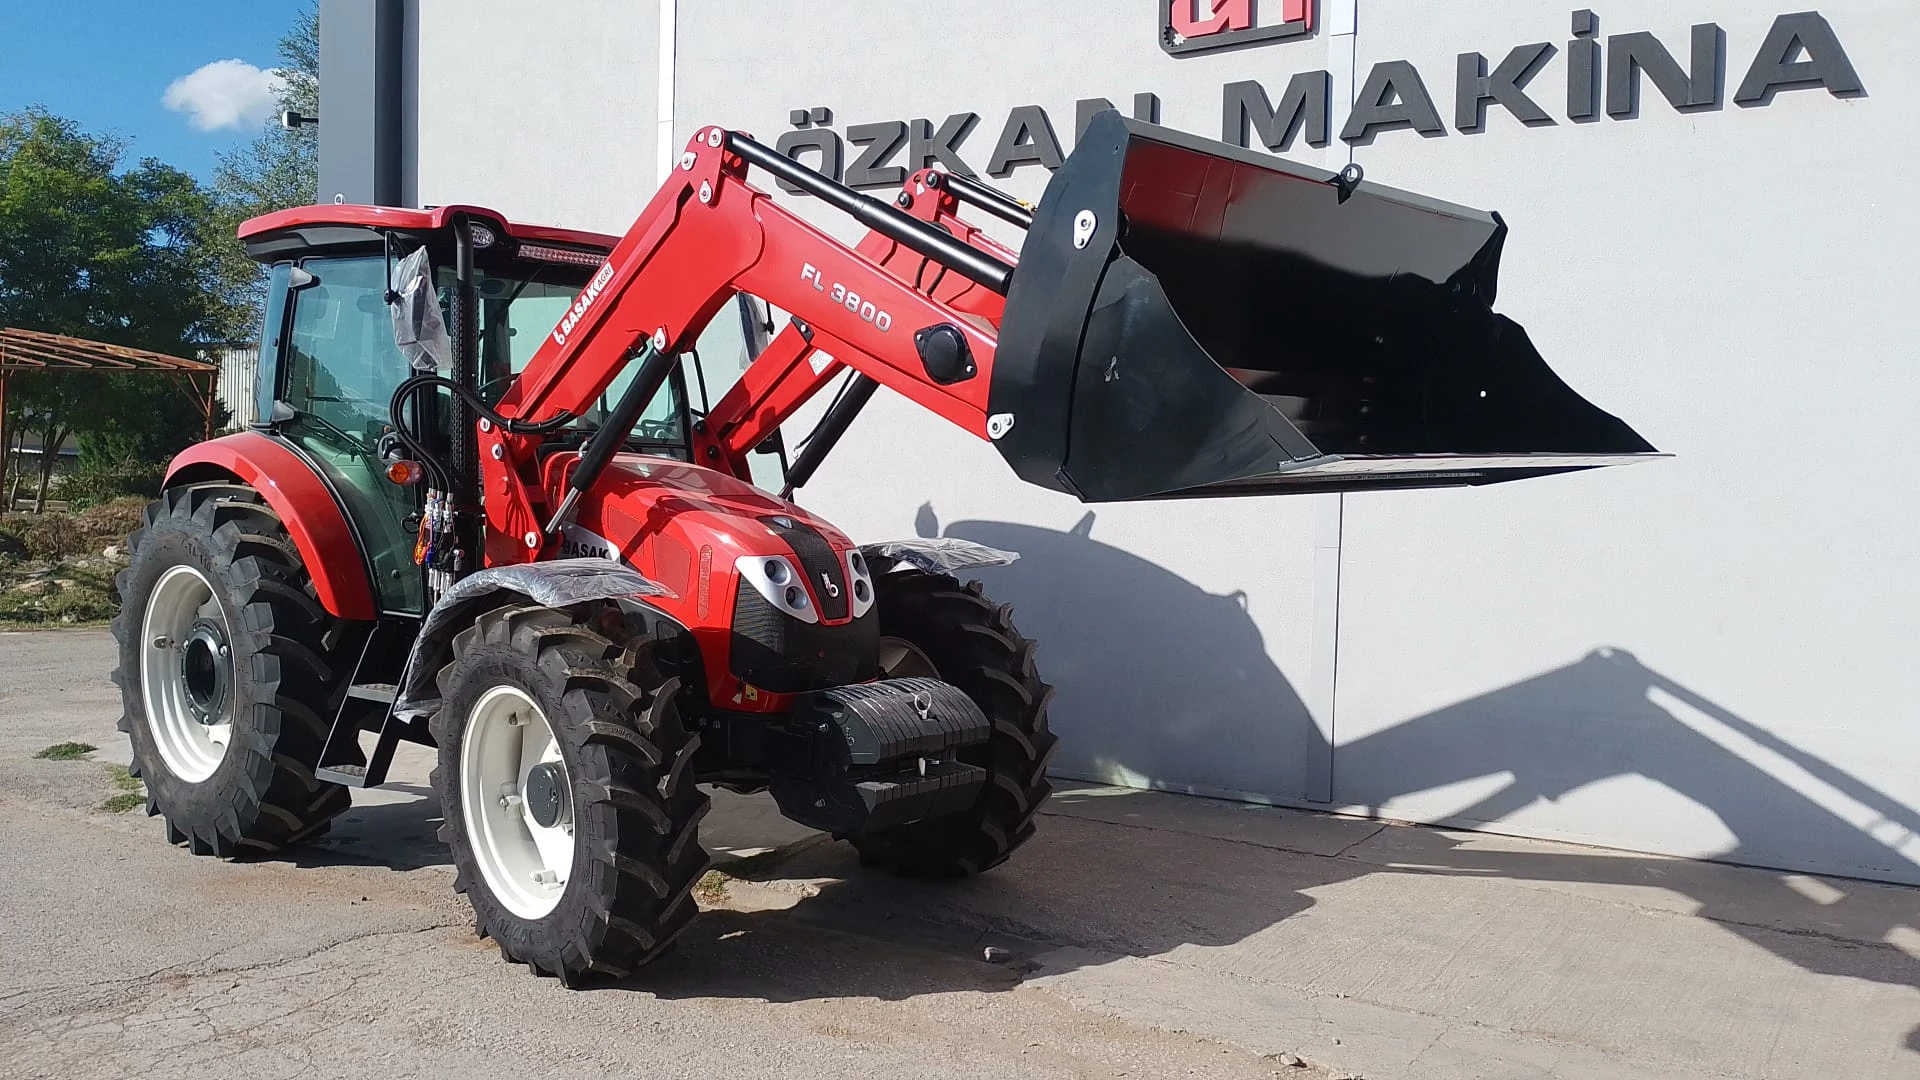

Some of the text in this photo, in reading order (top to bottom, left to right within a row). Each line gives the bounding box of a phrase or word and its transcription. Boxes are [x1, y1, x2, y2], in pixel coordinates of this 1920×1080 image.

[560, 265, 613, 336] BASAK AGRI
[800, 262, 892, 333] FL 3800
